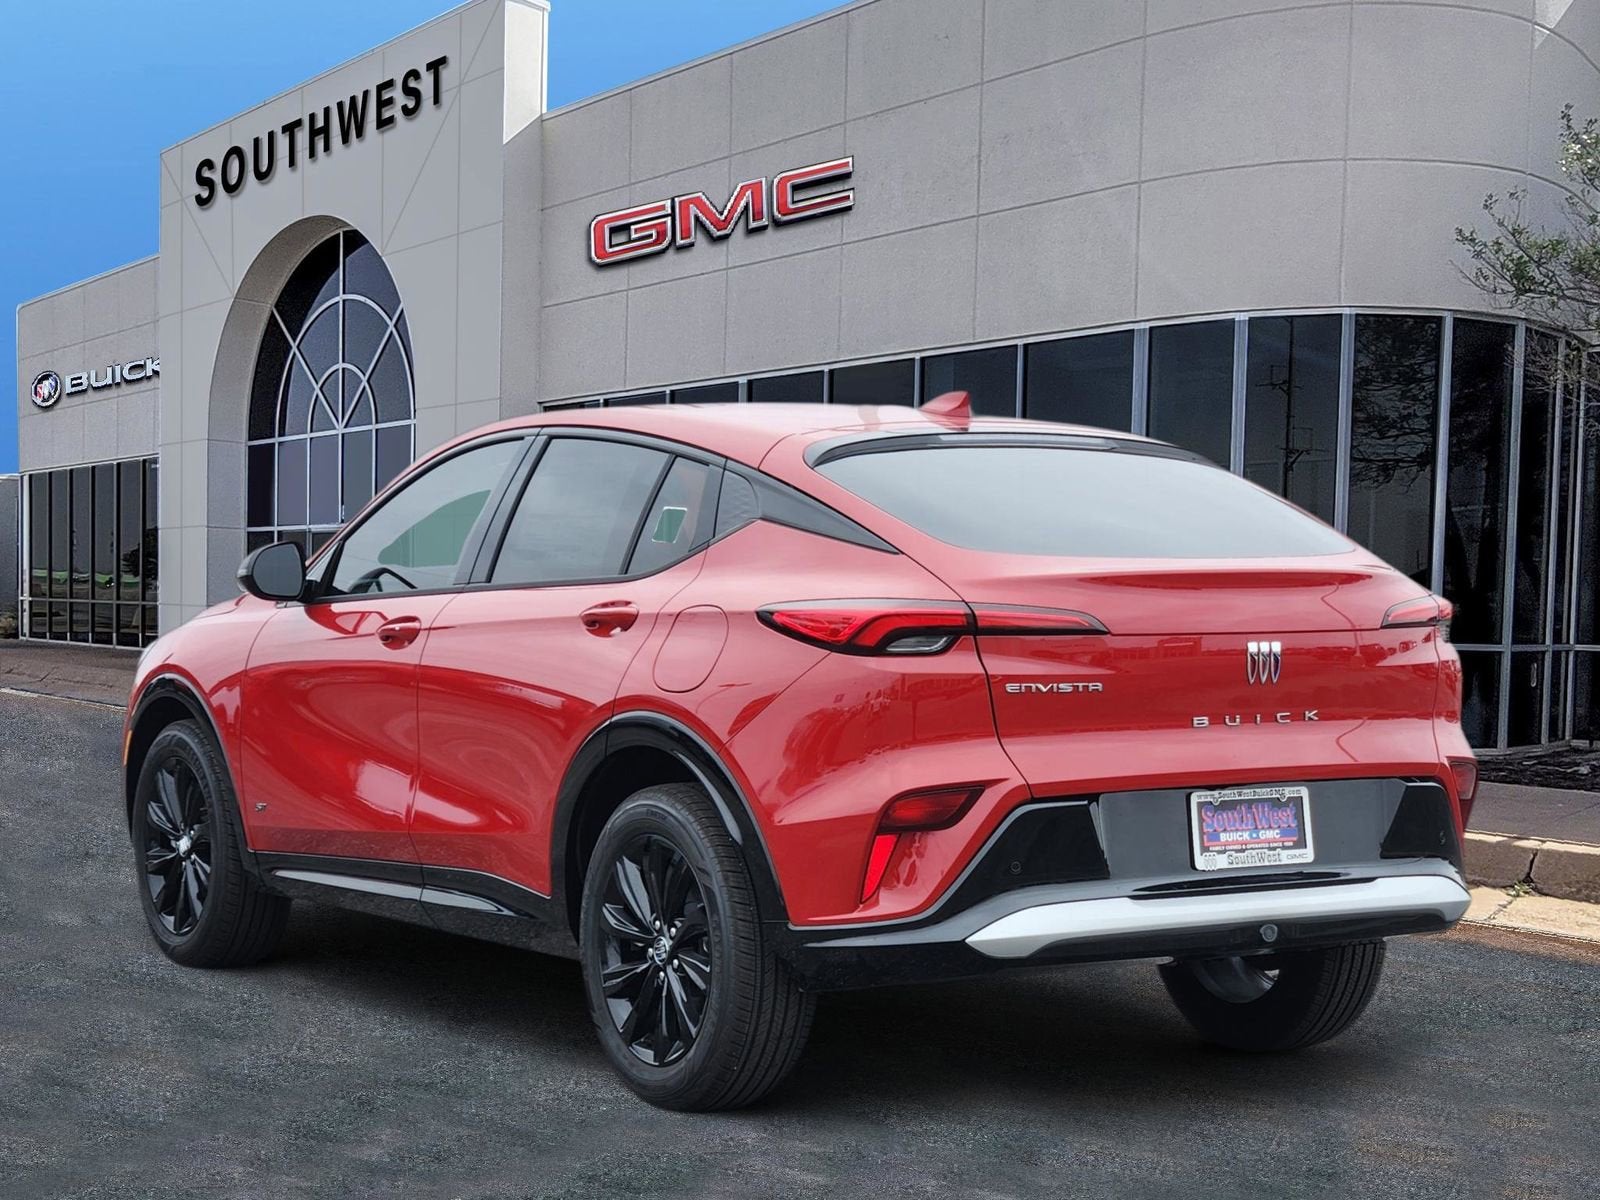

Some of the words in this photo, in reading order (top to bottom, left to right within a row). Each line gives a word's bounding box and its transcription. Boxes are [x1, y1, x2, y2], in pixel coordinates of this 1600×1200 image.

[194, 55, 448, 208] SOUTHWEST
[589, 155, 855, 266] GMC
[64, 357, 160, 395] BUICK
[1005, 682, 1103, 693] ENVISTA
[1192, 709, 1319, 728] BUICK
[1201, 802, 1298, 832] SouthWest
[1220, 831, 1250, 842] BUICK
[1259, 829, 1281, 839] GMC
[1227, 850, 1283, 865] SouthWest
